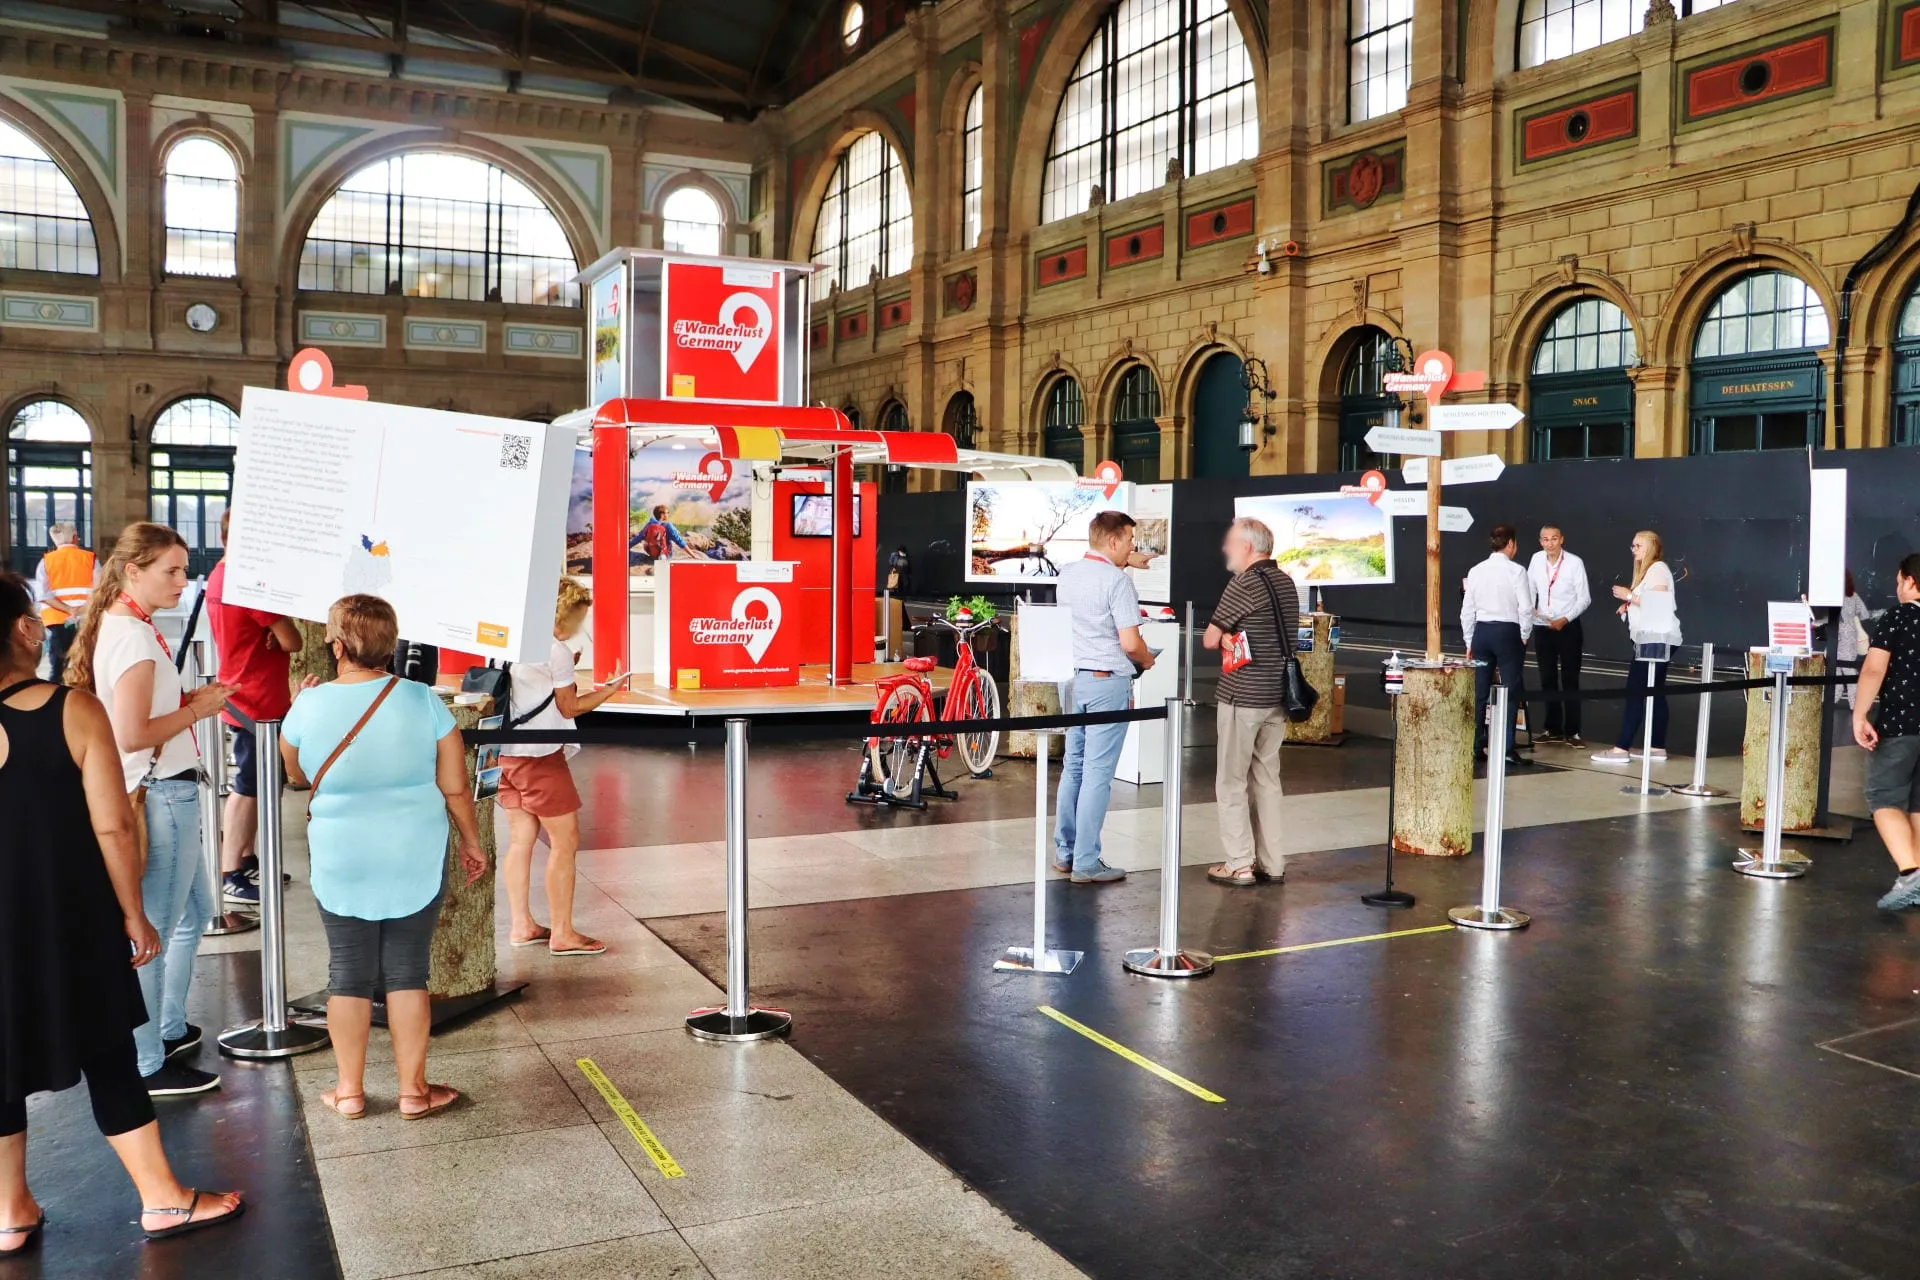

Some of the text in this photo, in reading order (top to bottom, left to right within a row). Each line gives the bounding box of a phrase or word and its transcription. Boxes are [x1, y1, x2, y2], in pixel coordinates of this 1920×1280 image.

[675, 321, 764, 339] #Wanderlust
[678, 334, 743, 352] Germany
[1383, 372, 1448, 384] #Wanderlust
[1385, 383, 1432, 393] Germany
[1722, 380, 1795, 395] DELIKATESSEN
[1572, 397, 1598, 406] SNACK
[671, 471, 728, 482] #Wanderlust
[672, 481, 715, 490] Germany
[691, 618, 774, 631] #Wanderlust
[693, 631, 754, 646] Germany
